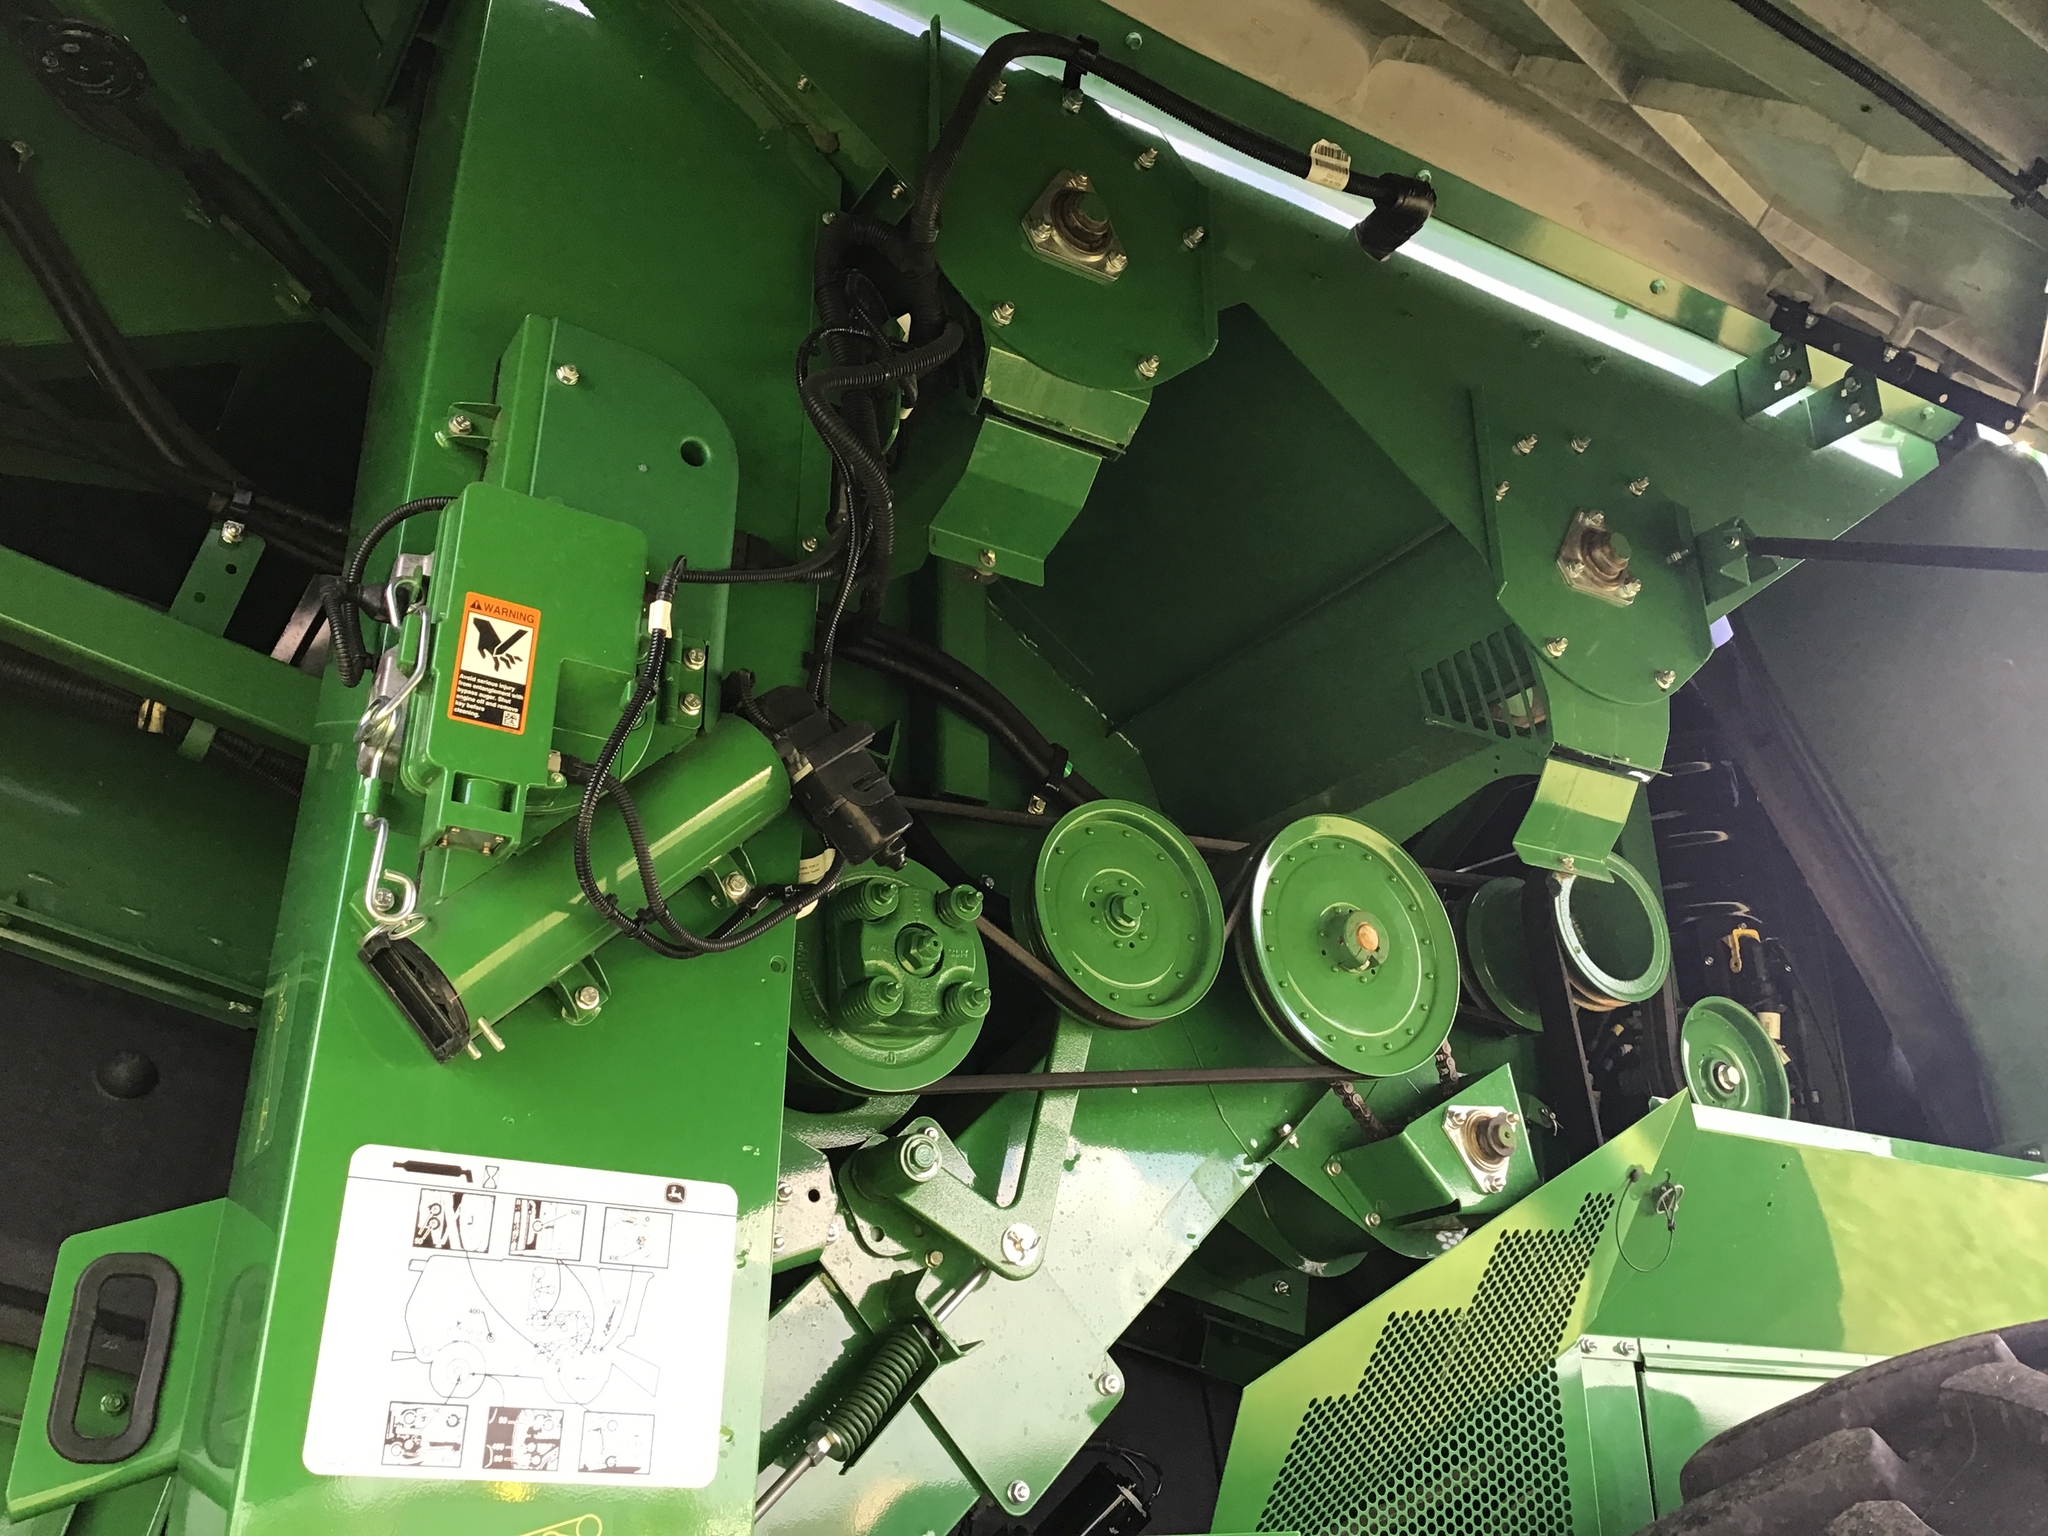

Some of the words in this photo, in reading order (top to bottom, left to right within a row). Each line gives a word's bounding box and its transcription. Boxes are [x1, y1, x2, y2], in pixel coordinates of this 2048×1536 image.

[483, 602, 535, 624] WARNING
[458, 679, 472, 688] from
[472, 684, 511, 698] entanglement
[511, 693, 524, 701] with
[459, 673, 477, 682] Avoid
[477, 678, 498, 688] serious
[498, 682, 516, 693] injury
[456, 693, 476, 703] engine
[485, 700, 497, 708] and
[497, 703, 519, 713] remove
[457, 686, 478, 697] bypass
[478, 692, 497, 701] auger.
[497, 695, 512, 705] Shut
[453, 706, 480, 719] cleaning.
[455, 699, 466, 709] key
[466, 702, 485, 712] before
[570, 1208, 582, 1216] 400
